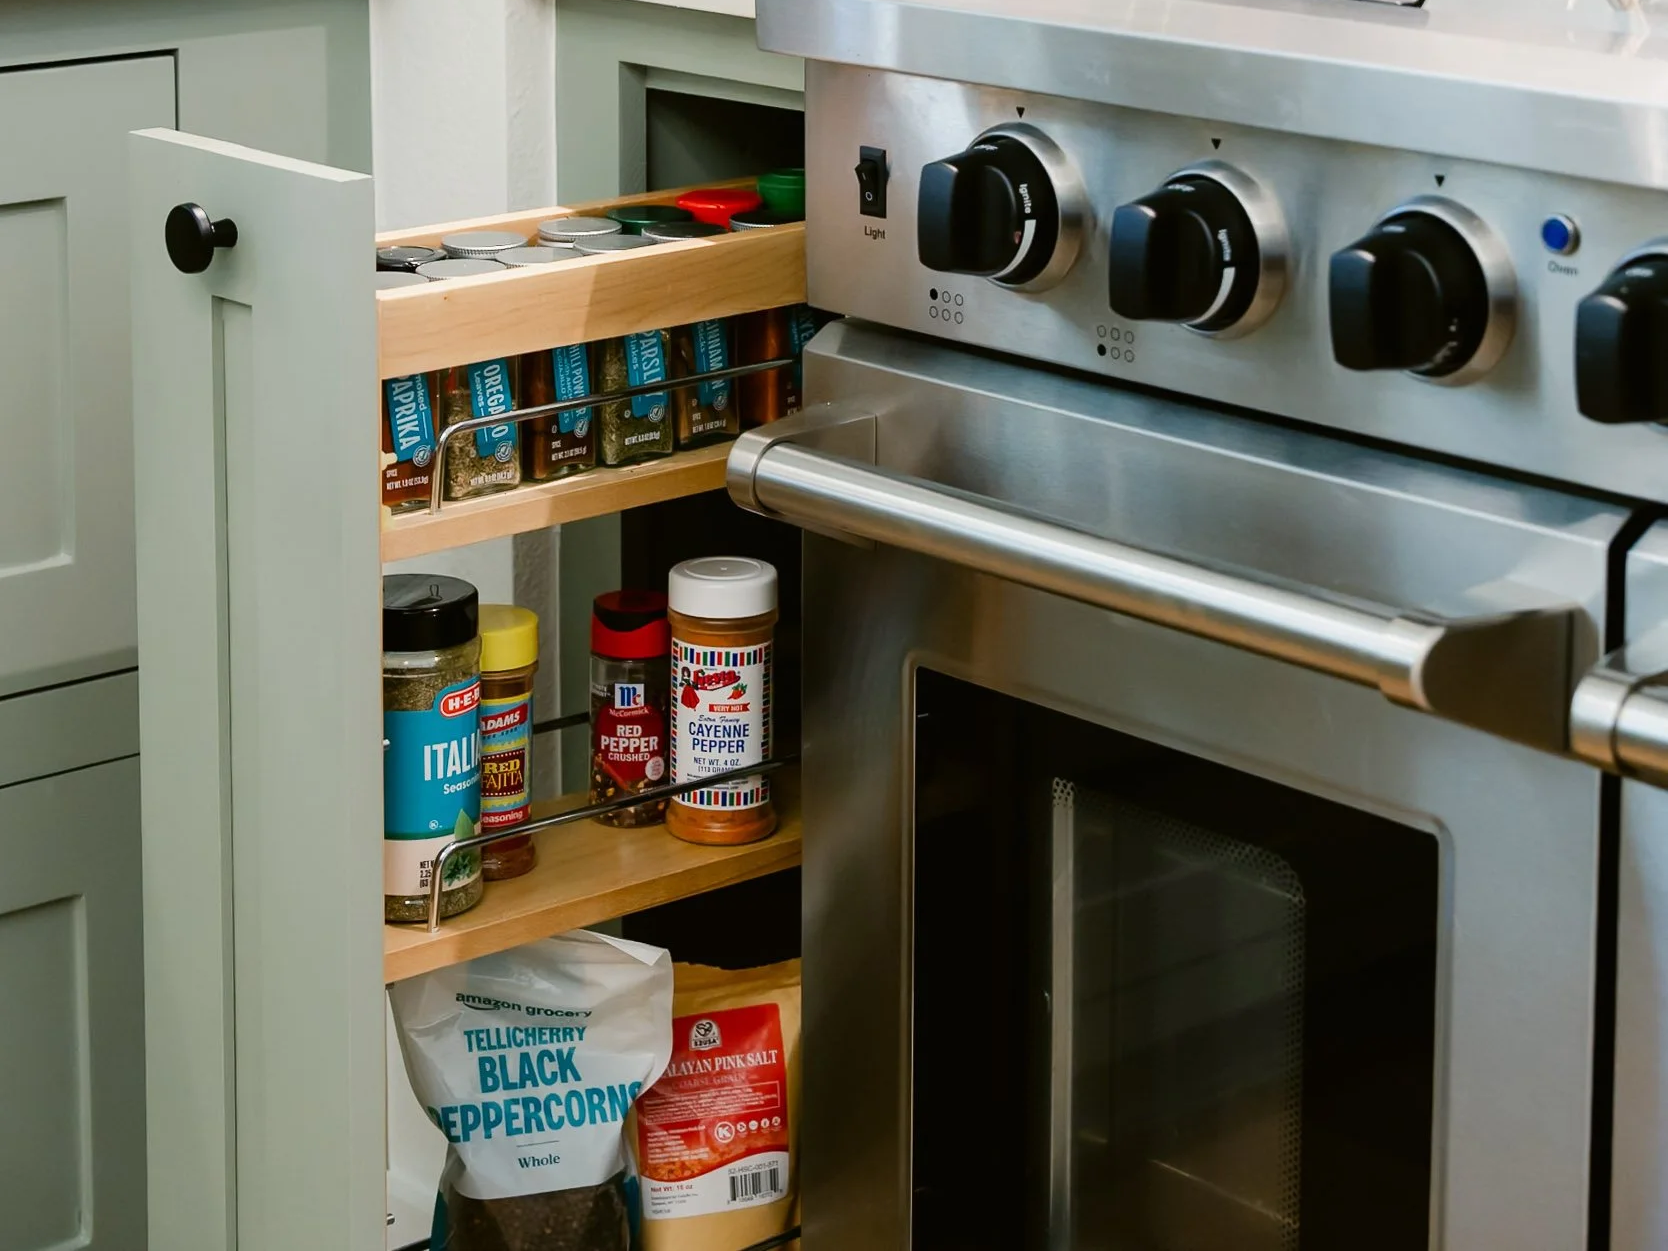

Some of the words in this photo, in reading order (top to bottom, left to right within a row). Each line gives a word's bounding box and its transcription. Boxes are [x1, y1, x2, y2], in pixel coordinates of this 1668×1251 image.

[1019, 183, 1032, 214] Ignite
[864, 225, 886, 240] Light
[568, 343, 582, 368] HILI
[639, 330, 663, 397] PARSL
[415, 374, 428, 411] moked
[474, 370, 485, 407] Leaves
[572, 367, 586, 417] POWR
[483, 364, 509, 438] OREGAO
[392, 376, 421, 451] APRIKA
[609, 706, 650, 718] McCormick
[713, 704, 729, 712] VERY
[480, 710, 521, 732] ADAMS
[698, 714, 716, 723] Extra
[616, 724, 642, 737] RED
[688, 721, 750, 739] CAYENNE
[600, 735, 659, 753] PEPPER
[692, 737, 746, 754] PEPPER
[484, 759, 520, 774] RED
[608, 752, 651, 762] CRUSHED
[693, 756, 706, 765] NET
[708, 758, 721, 766] WT.
[724, 759, 728, 767] 4
[730, 758, 742, 767] OZ.
[481, 770, 524, 790] FAJITA
[480, 809, 523, 826] easoning
[455, 992, 522, 1012] amazon
[525, 1004, 593, 1018] grocery
[463, 1025, 588, 1053] TELLICHERRY
[478, 1046, 582, 1094] BLACK
[663, 1058, 713, 1078] ALAYAN
[714, 1054, 747, 1071] PINK
[746, 1050, 778, 1067] SALT
[518, 1153, 561, 1169] Whole
